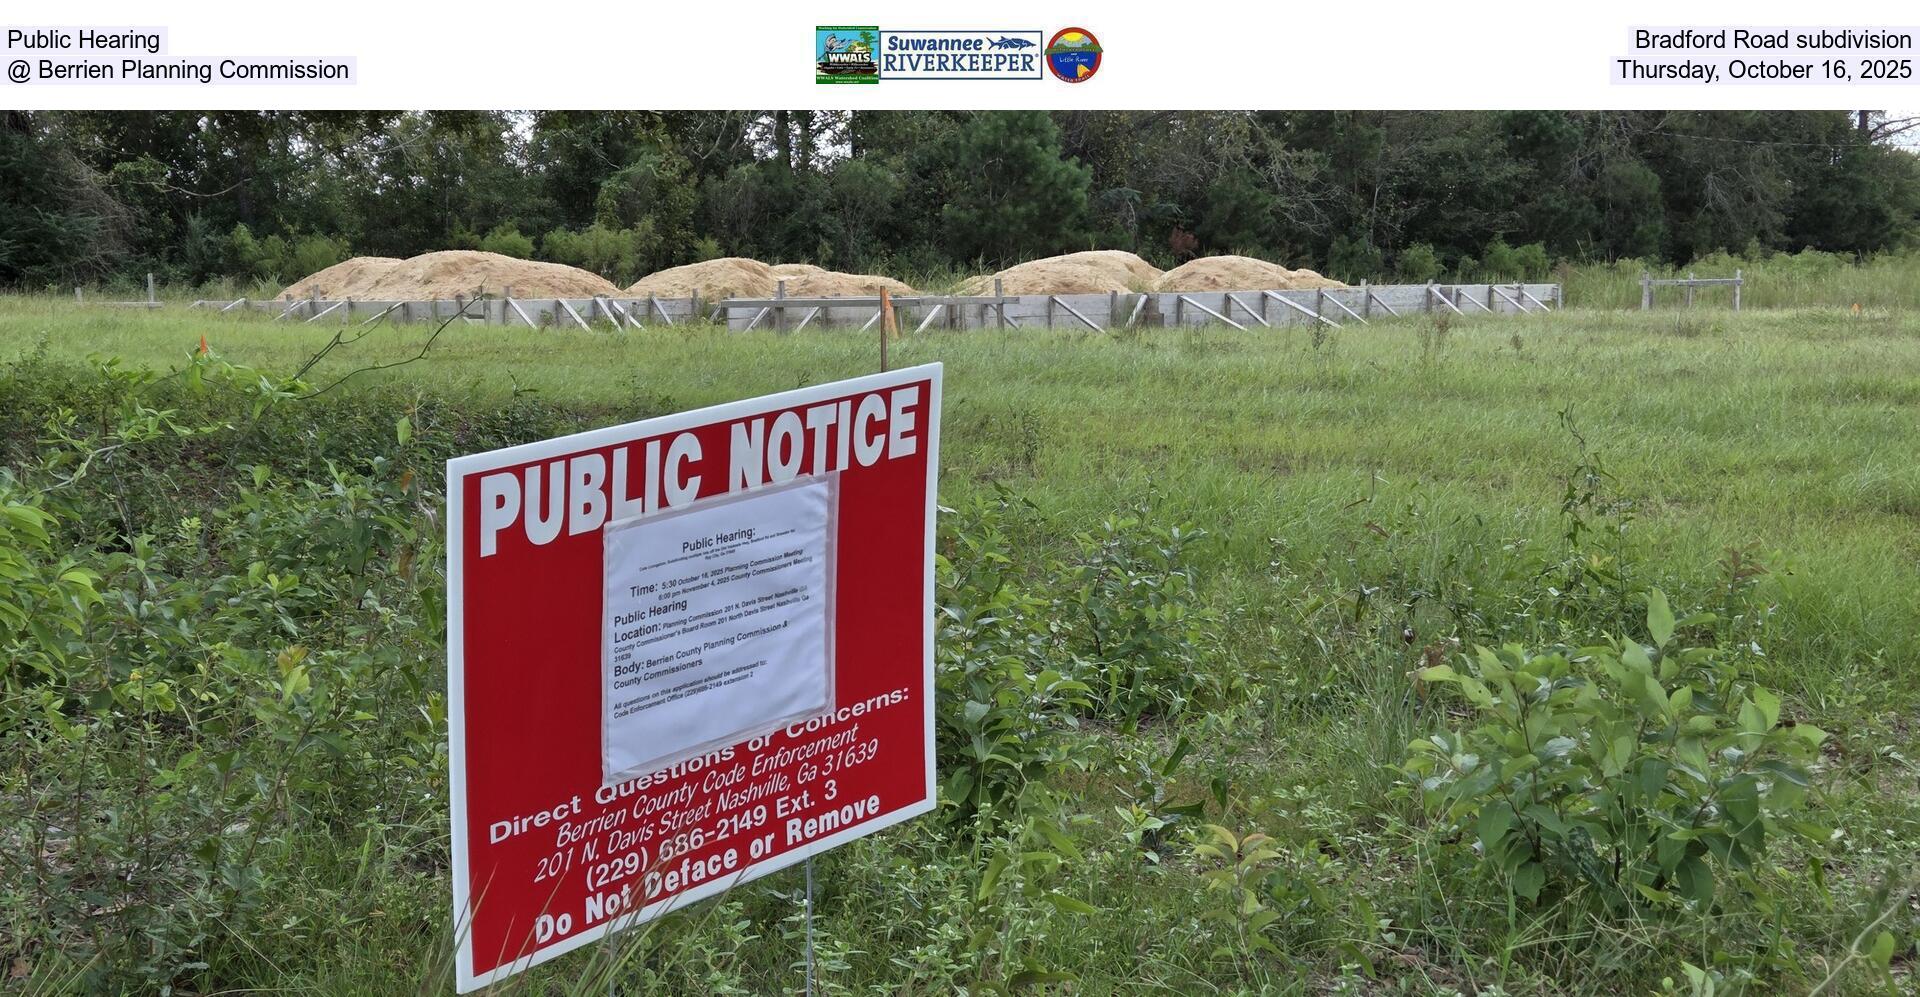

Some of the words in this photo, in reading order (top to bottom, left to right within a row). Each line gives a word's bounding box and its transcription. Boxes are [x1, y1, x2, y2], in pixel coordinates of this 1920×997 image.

[480, 432, 702, 557] PUBLIC
[729, 386, 919, 495] NOTICE
[683, 537, 713, 553] Public
[716, 528, 755, 544] Hearing:
[630, 583, 658, 597] Time:
[662, 579, 677, 589] 5:30
[678, 575, 700, 585] October
[711, 568, 723, 577] 2025
[725, 563, 748, 573] Planning
[750, 554, 782, 567] Commission
[784, 549, 803, 558] Meeting
[682, 583, 710, 594] November
[717, 576, 729, 585] 2025
[731, 572, 751, 582] County
[614, 610, 646, 627] Public
[649, 600, 687, 617] Hearing
[614, 622, 661, 643] Location:
[662, 618, 687, 629] Planning
[688, 609, 723, 622] Commission
[724, 604, 734, 613] 201
[742, 599, 756, 607] Davis
[614, 643, 635, 653] County
[636, 630, 680, 647] Commissioner's
[682, 624, 699, 634] Board
[700, 620, 716, 629] Room
[718, 616, 727, 624] 201
[728, 612, 743, 621] North
[744, 608, 758, 617] Davis
[614, 661, 644, 677] Body:
[646, 654, 674, 668] Berrien
[676, 646, 701, 659] County
[704, 636, 735, 651] Planning
[736, 623, 781, 641] Commission
[614, 676, 642, 689] County
[643, 659, 703, 681] Commissioners
[614, 702, 622, 710] All
[623, 694, 650, 708] questions
[660, 688, 671, 696] this
[614, 710, 629, 719] Code
[630, 698, 665, 714] Enforcement
[490, 795, 581, 844] Direct
[595, 745, 736, 804] Questions
[748, 731, 775, 752] or
[786, 687, 910, 738] Concerns:
[556, 807, 627, 848] Berrien
[632, 782, 699, 820] County
[703, 762, 746, 794] Code
[752, 723, 860, 776] Enforcement
[534, 847, 575, 883] 201
[581, 842, 599, 864] N.
[608, 819, 654, 855] Davis
[659, 803, 712, 836] Street
[716, 770, 791, 815] Nashville,
[798, 762, 816, 784] Ga
[822, 739, 878, 776] 31639
[586, 846, 648, 891] (229)
[659, 805, 767, 863] 686-2149
[776, 790, 815, 819] Ext.
[824, 780, 837, 800] 3
[535, 912, 571, 944] Do
[585, 884, 632, 924] Not
[645, 848, 738, 898] Deface
[750, 832, 775, 859] or
[786, 794, 880, 846] Remove
